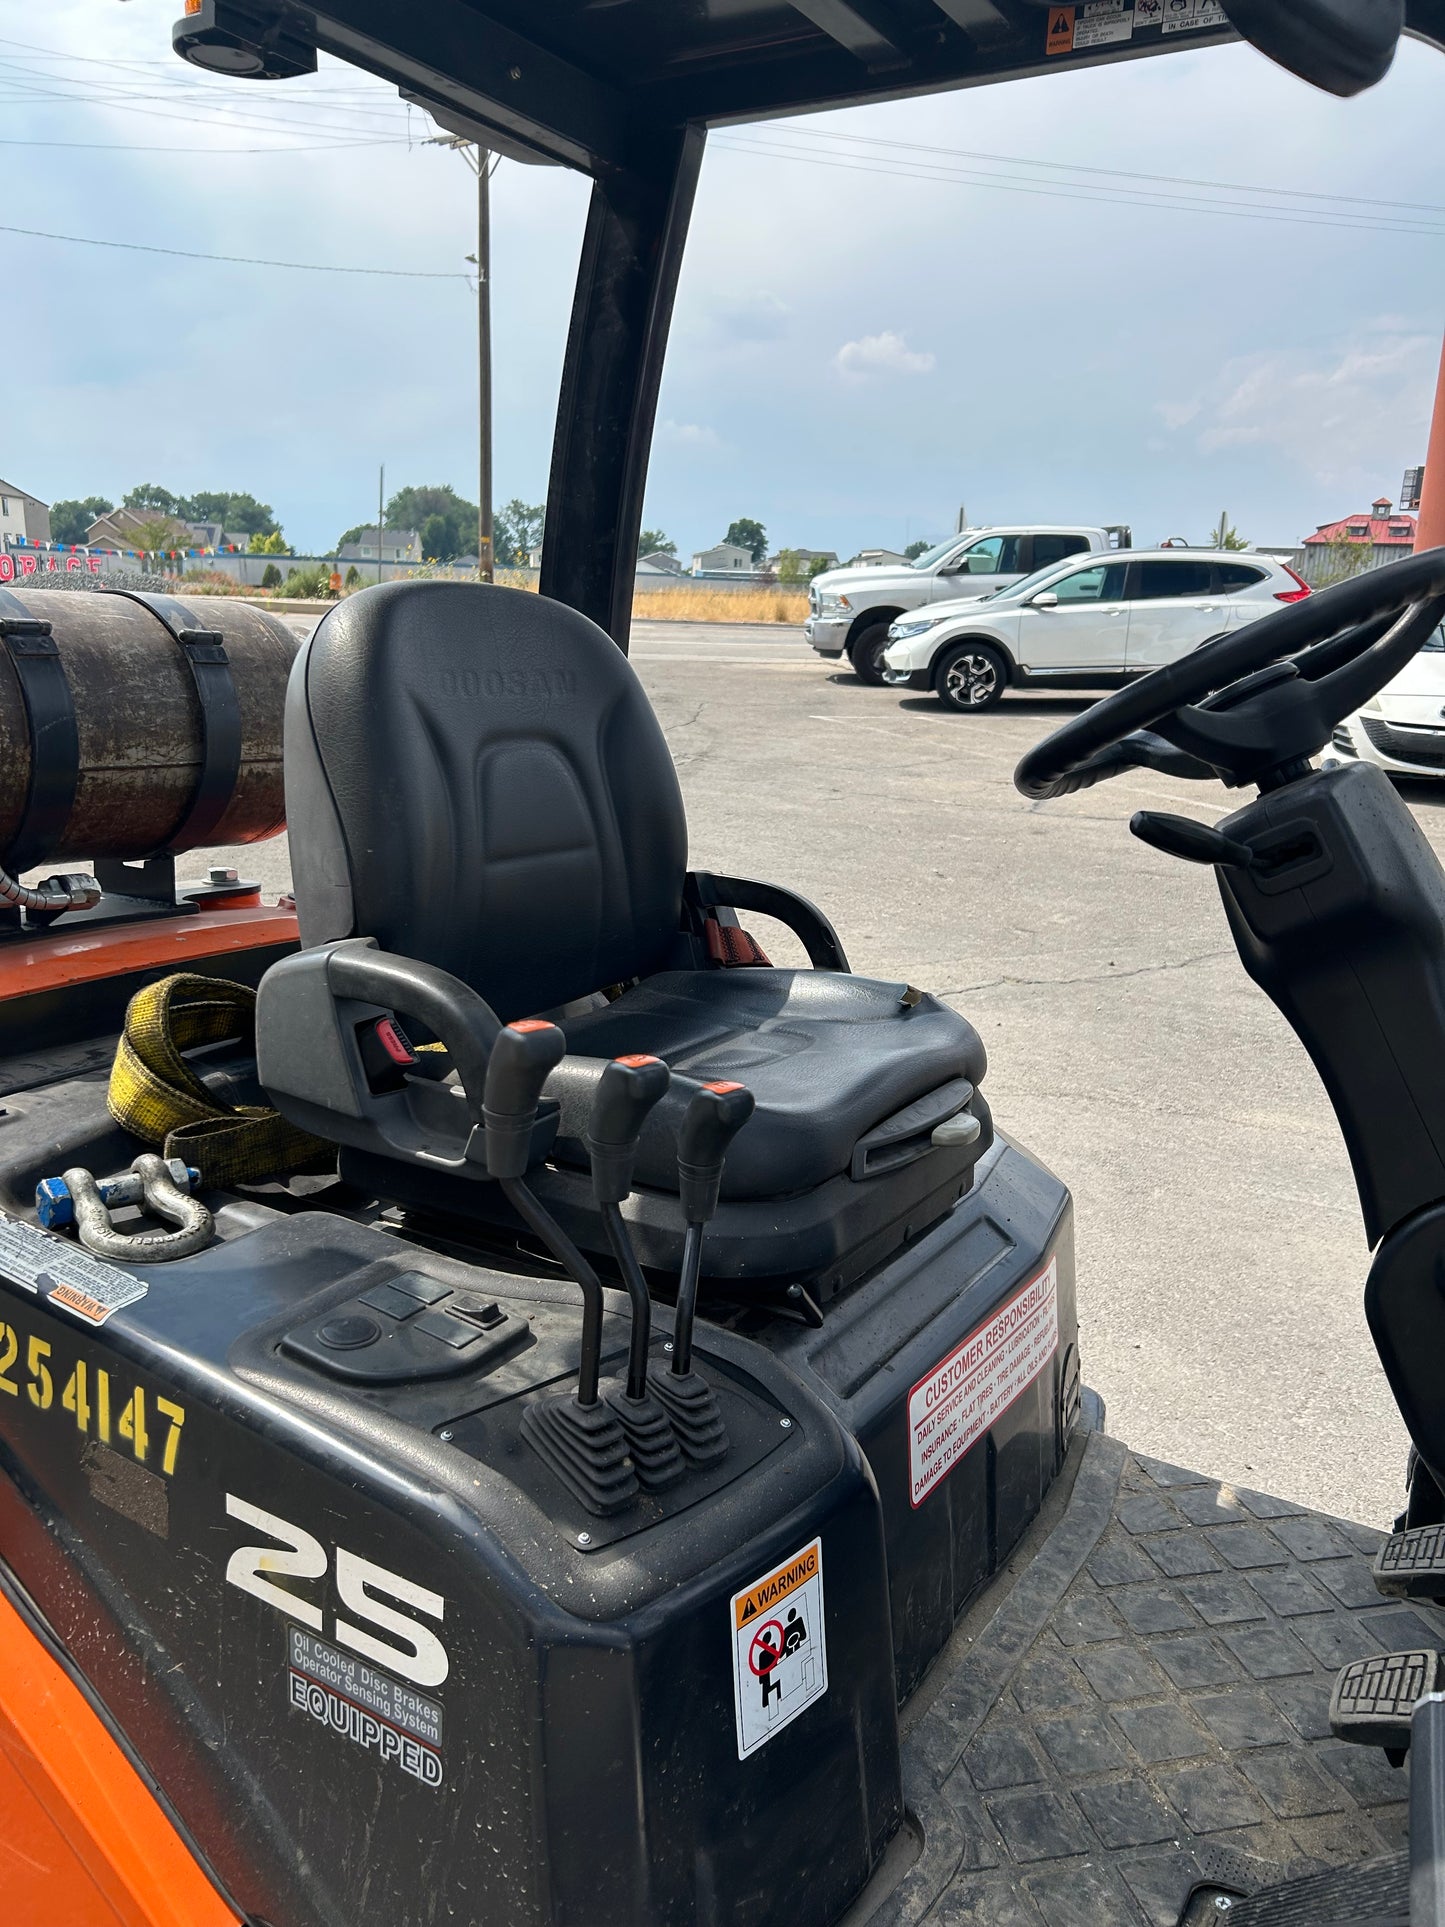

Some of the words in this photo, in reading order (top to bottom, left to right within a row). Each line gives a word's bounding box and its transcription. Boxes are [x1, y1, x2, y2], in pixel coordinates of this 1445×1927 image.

[1048, 38, 1071, 48] WARNING
[1180, 19, 1199, 28] CASE
[56, 1285, 95, 1313] WARNING
[0, 1321, 185, 1475] 254147
[914, 1455, 943, 1497] DAMAGE
[942, 1444, 954, 1462] TO
[952, 1413, 987, 1457] EQUIPMENT
[990, 1385, 1014, 1415] BATTERY
[1016, 1366, 1027, 1387] ALL
[1026, 1355, 1038, 1375] OILS
[1038, 1345, 1048, 1362] AND
[916, 1413, 937, 1446] DAILY
[937, 1390, 964, 1425] SERVICE
[963, 1377, 978, 1402] AND
[977, 1349, 1005, 1386] CLEANING
[1007, 1315, 1042, 1355] LUBRICATION
[921, 1418, 958, 1466] INSURANCE
[961, 1398, 978, 1426] FLAT
[977, 1384, 994, 1409] TIRES
[996, 1364, 1010, 1388] TIRE
[1009, 1343, 1031, 1376] DAMAGE
[925, 1342, 984, 1408] CUSTOMER
[225, 1492, 450, 1687] 25
[757, 1553, 816, 1608] WARNING
[293, 1630, 310, 1653] Oil
[314, 1641, 355, 1678] Cooled
[361, 1665, 388, 1695] Disc
[393, 1684, 439, 1724] Brakes
[293, 1648, 342, 1688] Operator
[344, 1675, 392, 1717] Sensing
[394, 1705, 438, 1740] System
[290, 1671, 443, 1788] EQUIPPED
